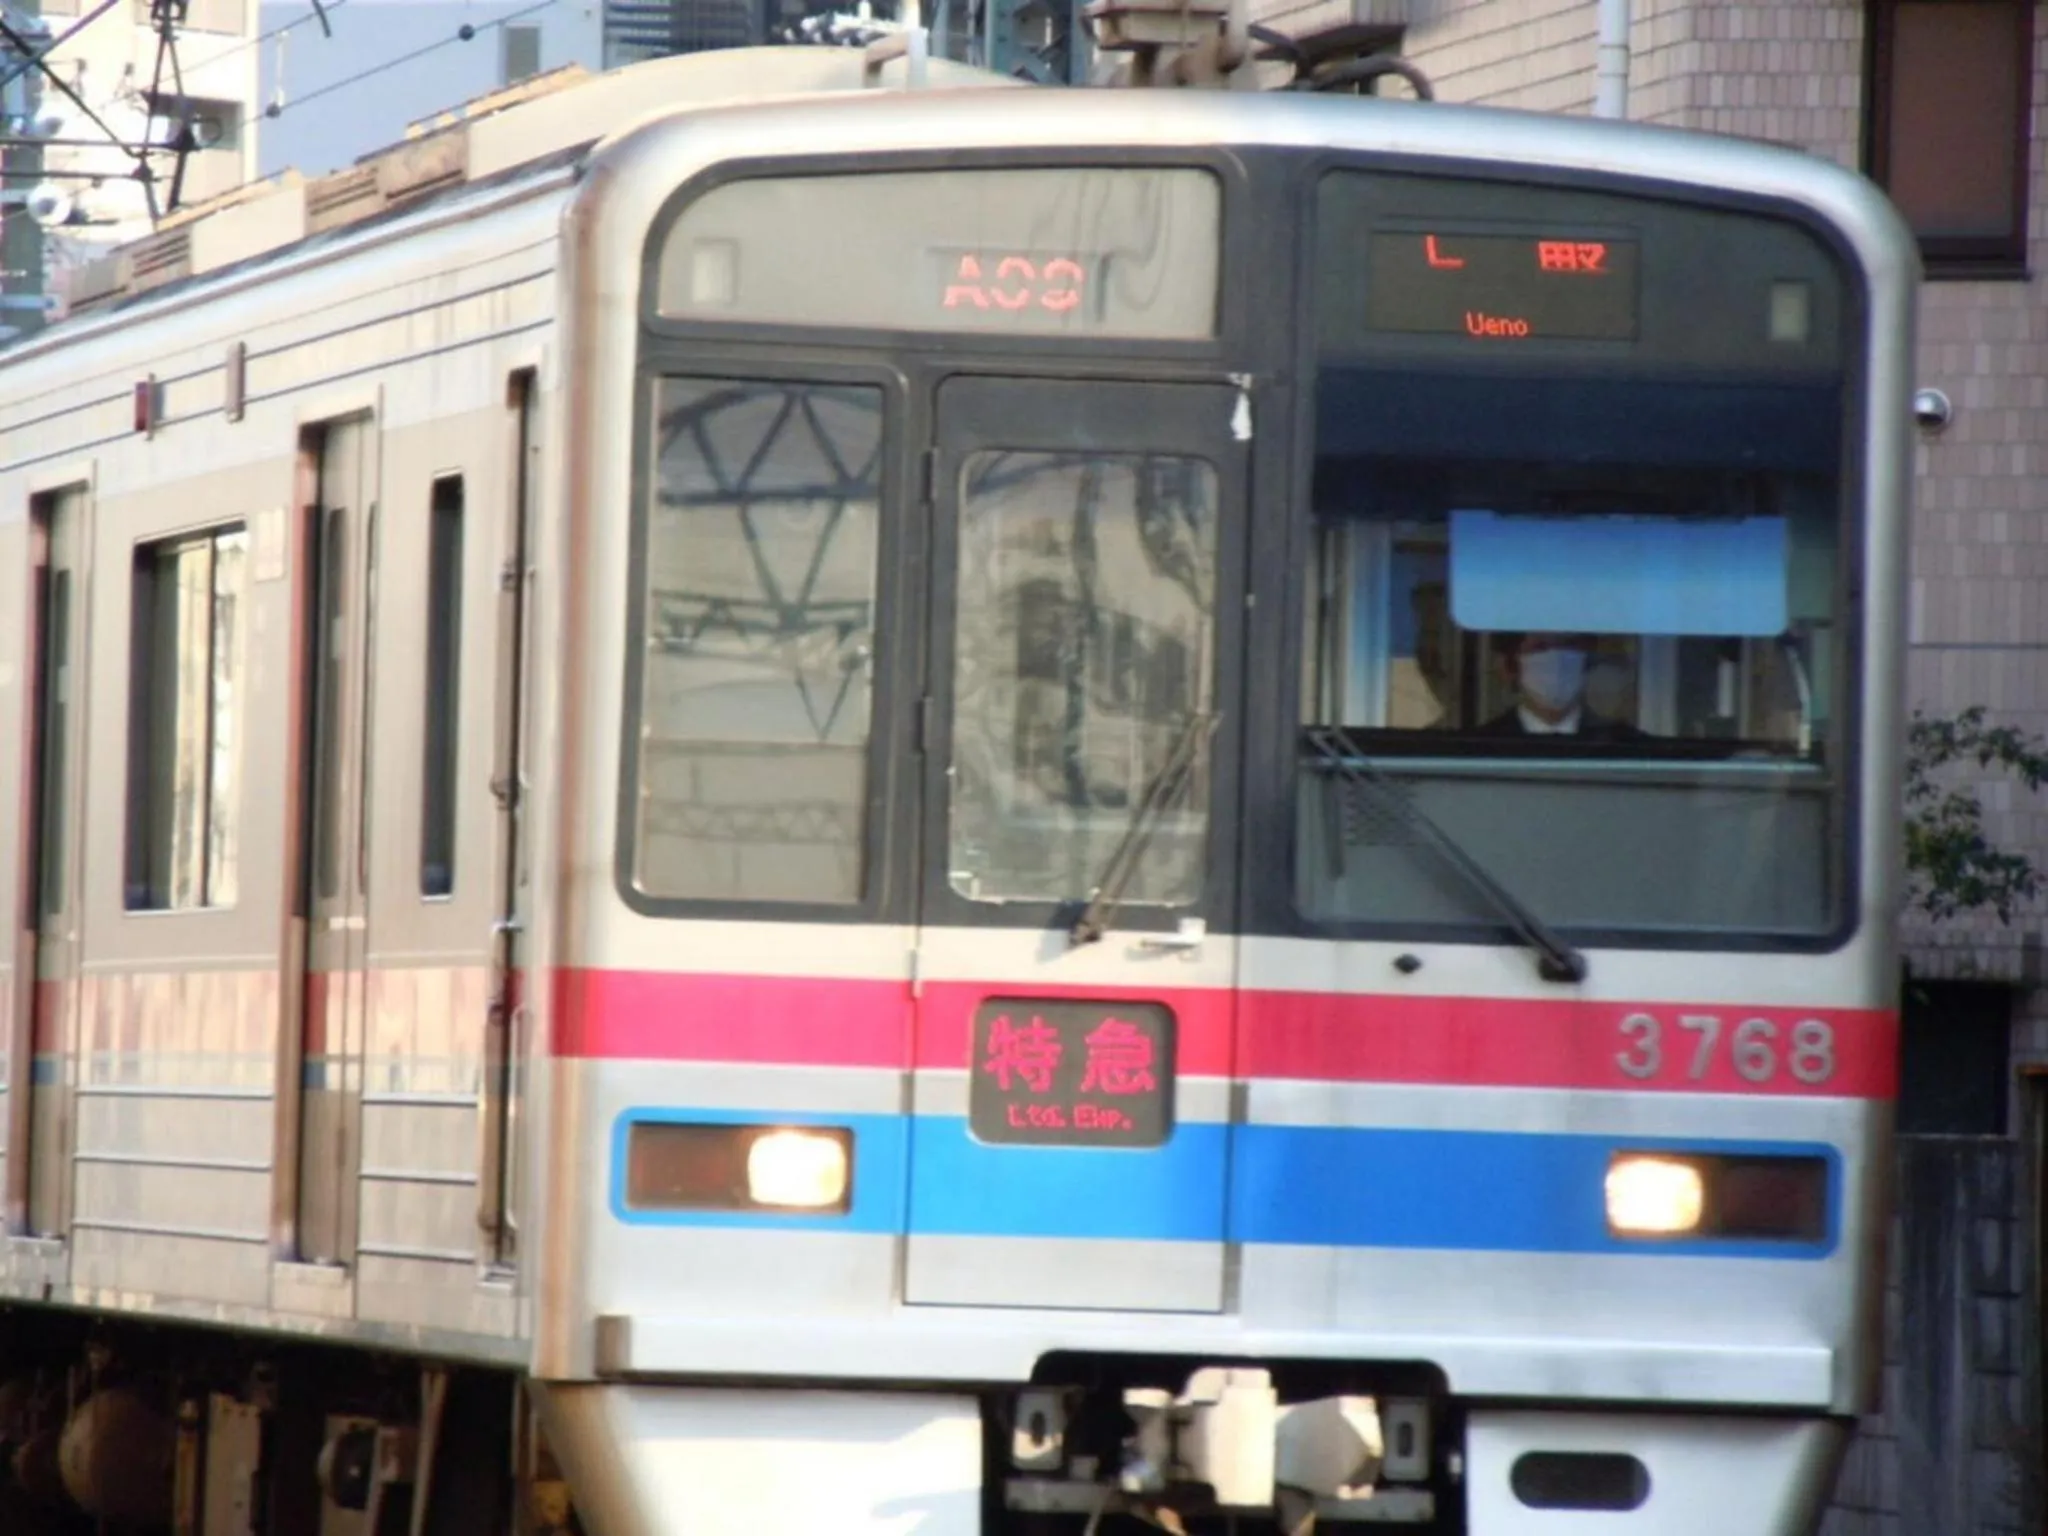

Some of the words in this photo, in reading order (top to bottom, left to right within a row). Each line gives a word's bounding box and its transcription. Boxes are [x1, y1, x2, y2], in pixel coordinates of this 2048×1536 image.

[1466, 311, 1528, 336] Ueno
[984, 1014, 1155, 1095] 特急
[1616, 1012, 1836, 1083] 3768
